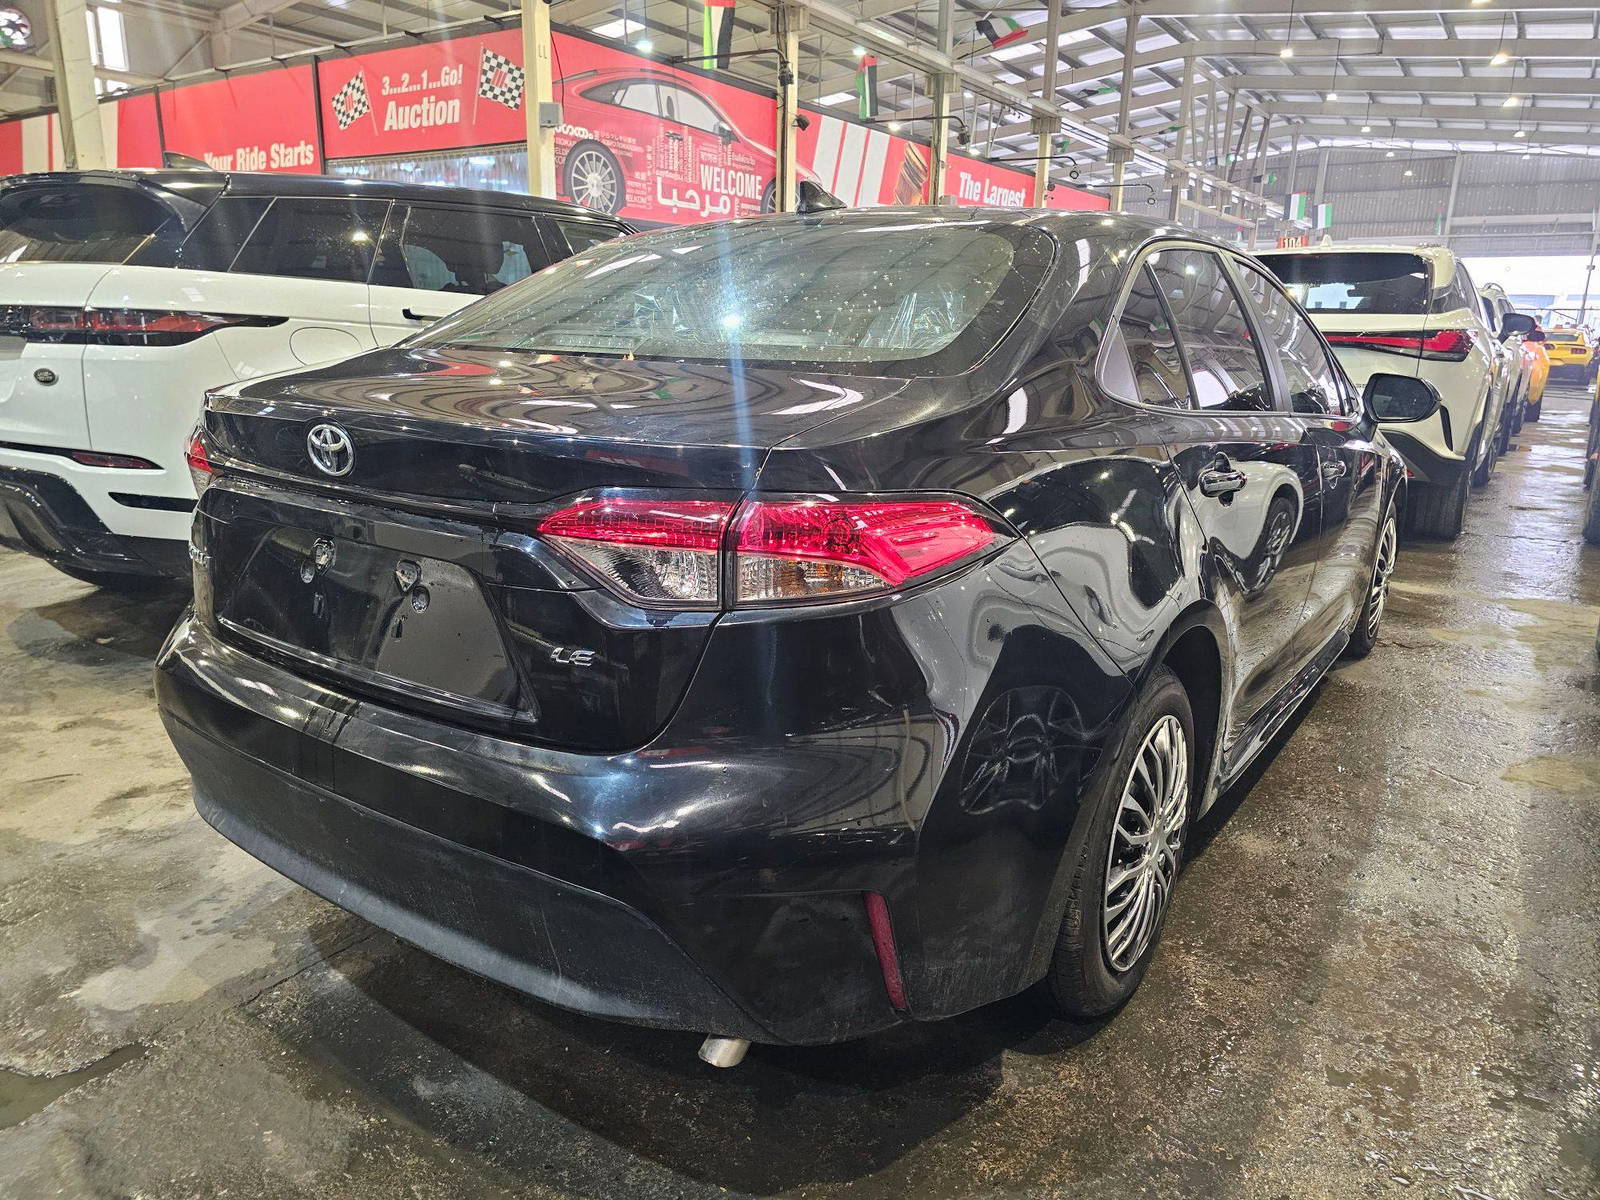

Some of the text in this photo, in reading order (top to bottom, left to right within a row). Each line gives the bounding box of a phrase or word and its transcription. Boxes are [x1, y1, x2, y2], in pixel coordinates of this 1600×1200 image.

[383, 96, 461, 132] Auction
[203, 140, 315, 171] Your Ride Starts
[656, 175, 731, 218] مرحبا
[700, 164, 763, 200] WELCOME
[959, 171, 1026, 207] The Largest
[550, 647, 595, 667] LE
